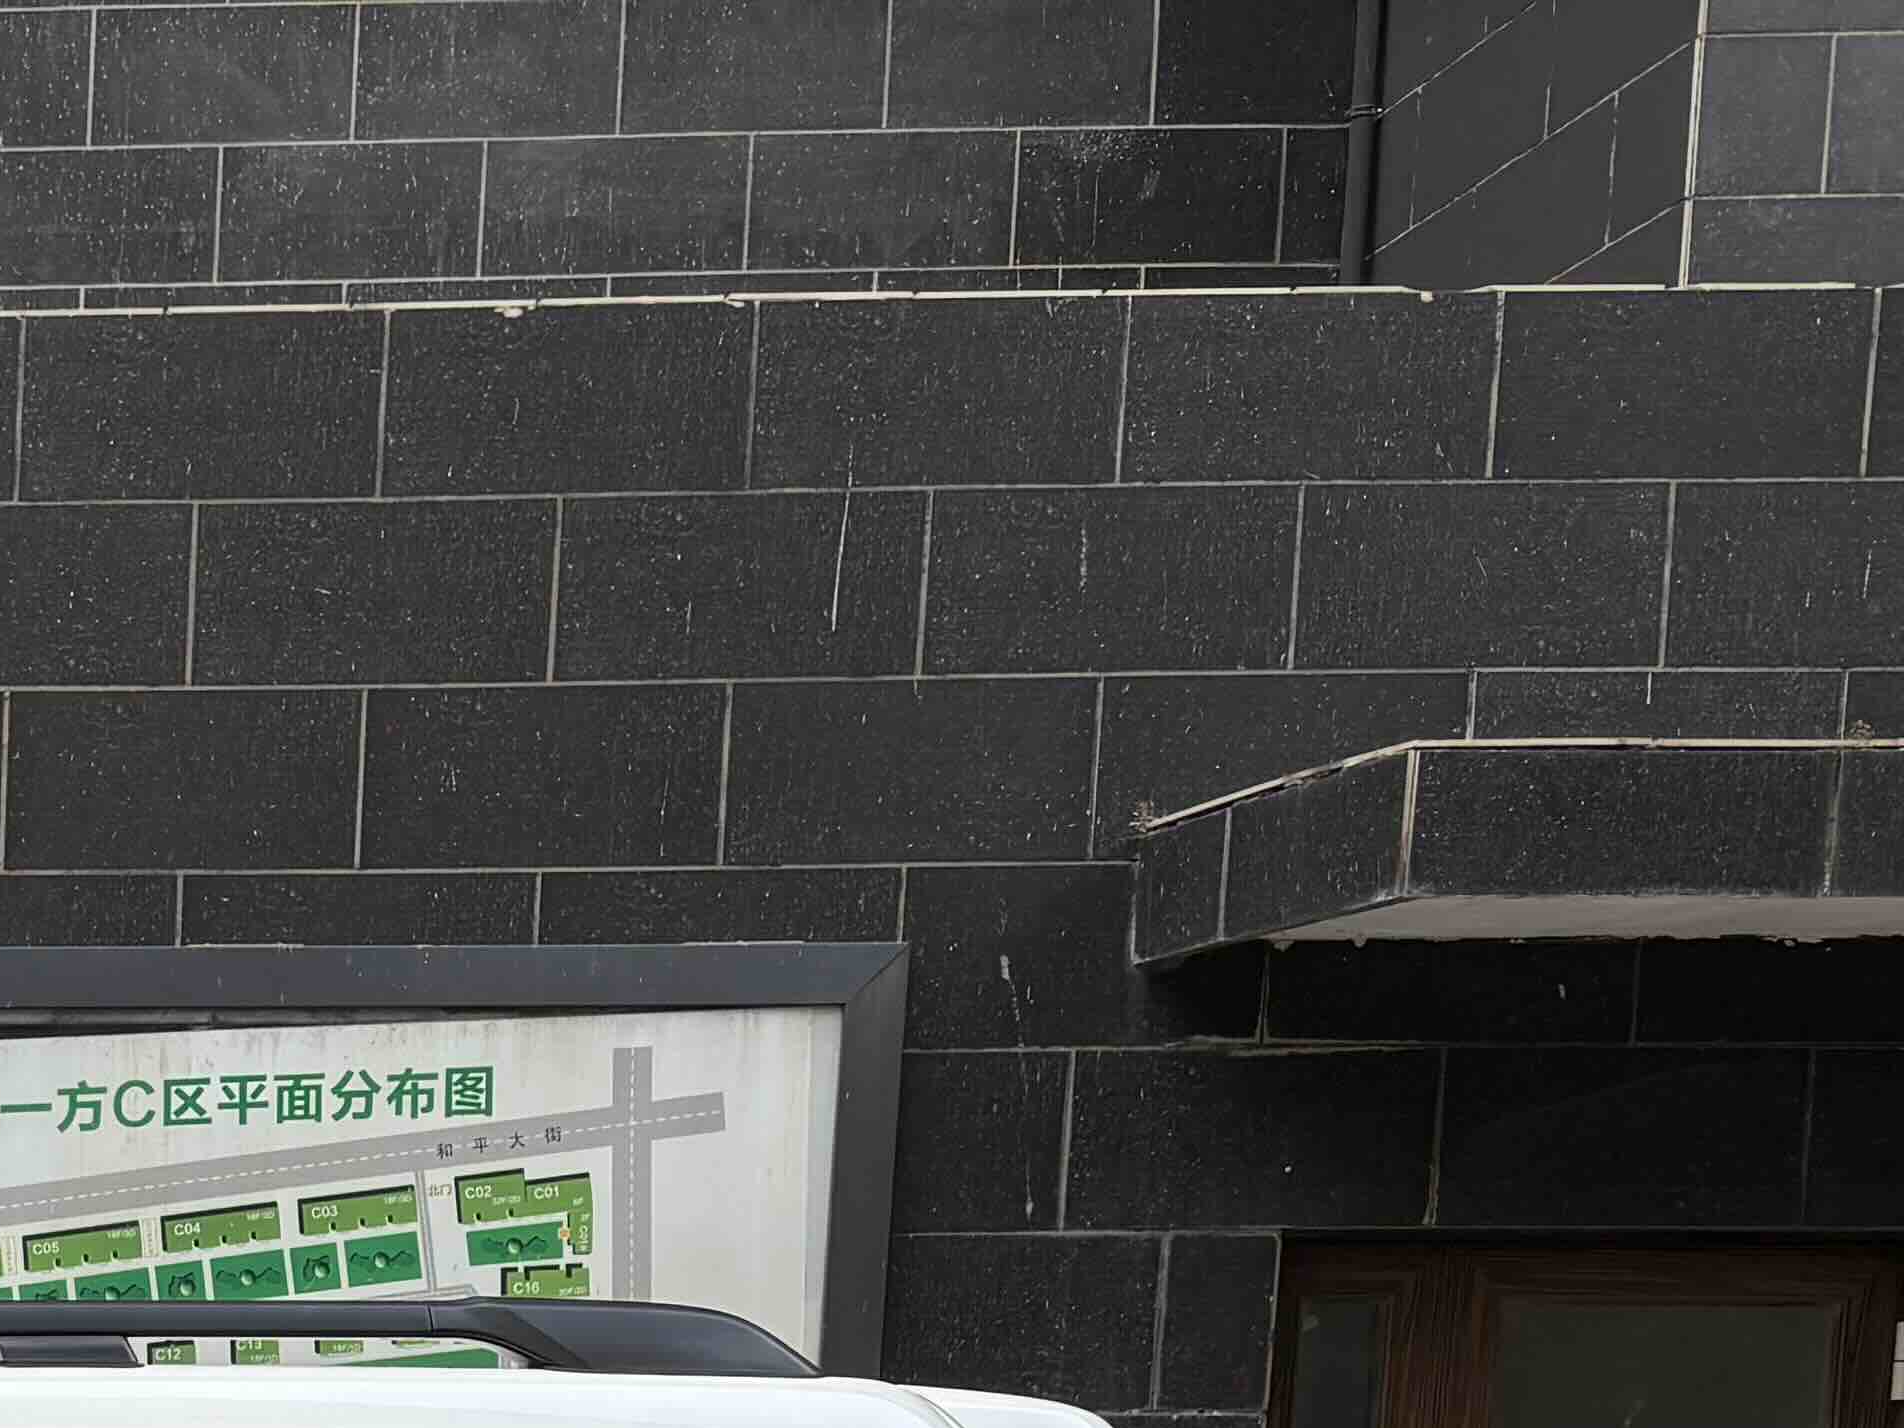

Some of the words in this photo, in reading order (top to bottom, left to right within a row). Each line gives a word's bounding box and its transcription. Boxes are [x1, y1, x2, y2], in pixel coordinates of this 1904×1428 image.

[436, 1126, 562, 1159] 和平大街
[465, 1184, 492, 1199] C02
[534, 1185, 560, 1199] C01
[311, 1204, 338, 1218] C03
[173, 1222, 201, 1236] C04
[32, 1241, 60, 1255] C05
[513, 1281, 540, 1295] C16
[155, 1347, 182, 1361] C12
